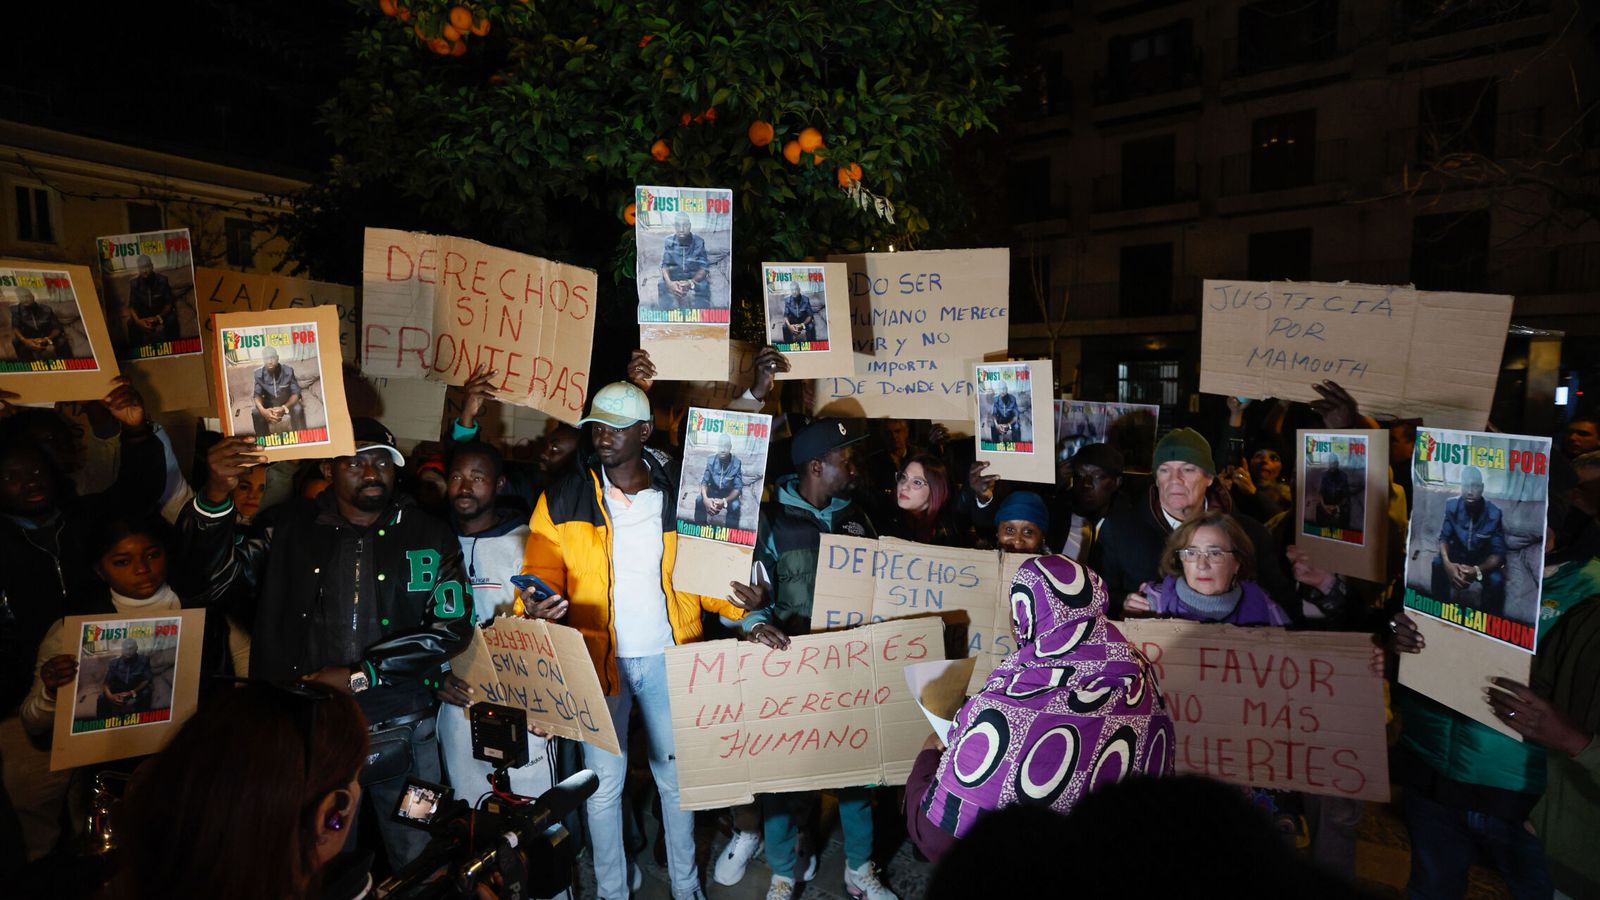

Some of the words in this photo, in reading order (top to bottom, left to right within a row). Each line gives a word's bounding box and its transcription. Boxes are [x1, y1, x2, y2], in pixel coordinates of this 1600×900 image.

[706, 198, 730, 214] POR
[209, 276, 252, 312] LA
[387, 244, 589, 321] DERECHOS
[898, 272, 943, 295] SER
[940, 305, 1007, 322] MERECE
[1210, 285, 1394, 319] JUSTICIA
[457, 296, 523, 342] SIN
[1268, 317, 1327, 342] POR
[291, 330, 316, 345] POR
[852, 336, 889, 352] IVIR
[896, 339, 906, 356] Y
[922, 332, 951, 347] NO
[364, 324, 586, 412] FRONTERAS
[867, 359, 939, 377] IMPORTA
[1246, 346, 1369, 379] MAMOUTH
[830, 378, 865, 399] DE
[879, 380, 935, 395] DONDE
[747, 422, 769, 438] POR
[1434, 441, 1506, 470] JUSTICIA
[1508, 449, 1547, 476] POR
[676, 519, 715, 539] Mamouth
[828, 544, 980, 588] DERECHOS
[887, 585, 944, 609] SIN
[1404, 585, 1464, 627] Mamouth
[482, 629, 554, 659] MUERTES
[491, 652, 529, 677] MAS
[538, 658, 564, 686] NO
[688, 639, 870, 694] MIGRAR
[882, 634, 929, 661] ES
[1200, 647, 1335, 697] FAVOR
[479, 682, 548, 713] FAVOR
[546, 688, 600, 732] POR
[695, 702, 744, 730] UN
[759, 686, 891, 721] DERECHO
[1162, 691, 1203, 724] NO
[719, 724, 869, 760] HUMANO
[1183, 735, 1366, 795] UERTES
